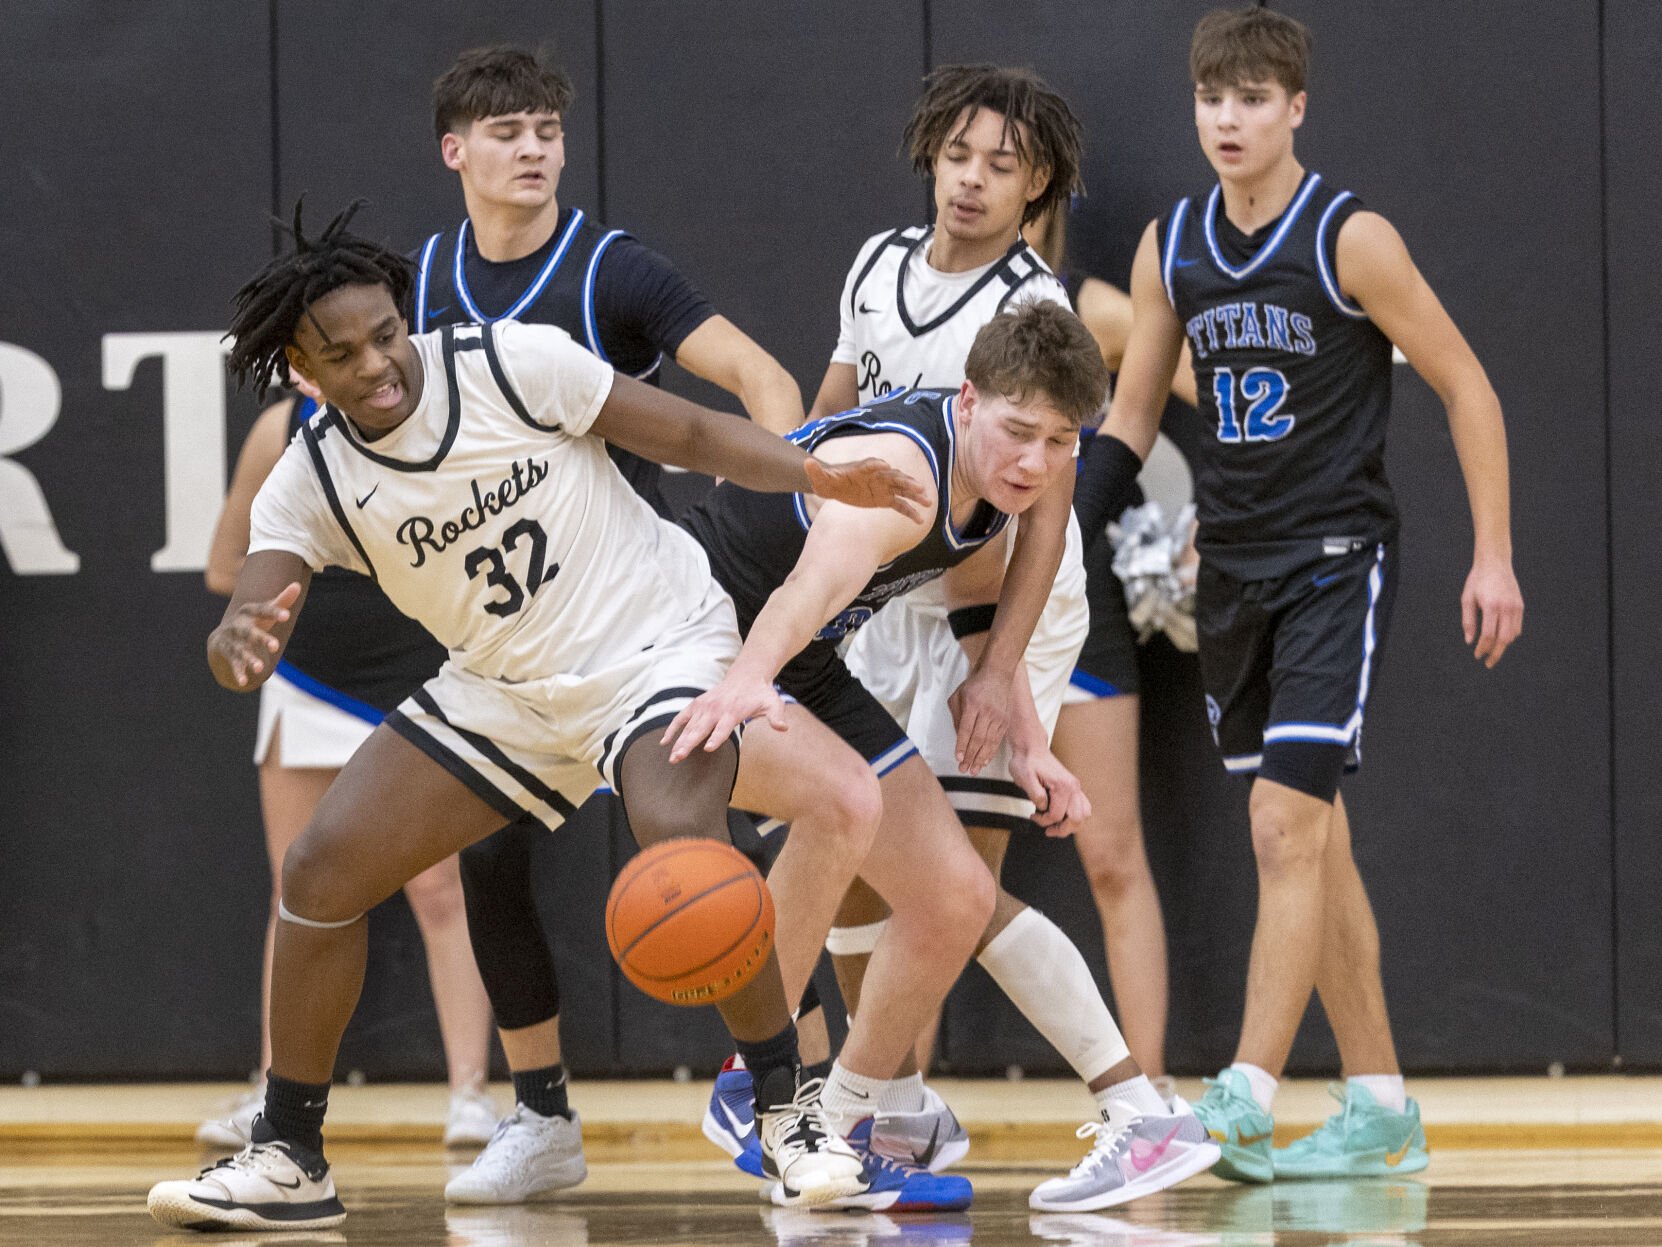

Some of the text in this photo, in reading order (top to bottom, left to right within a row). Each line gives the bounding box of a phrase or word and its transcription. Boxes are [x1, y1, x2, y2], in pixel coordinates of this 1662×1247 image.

[1186, 302, 1316, 359] TITANS
[1213, 366, 1295, 443] 12
[396, 458, 548, 568] Rockets
[465, 518, 560, 618] 32
